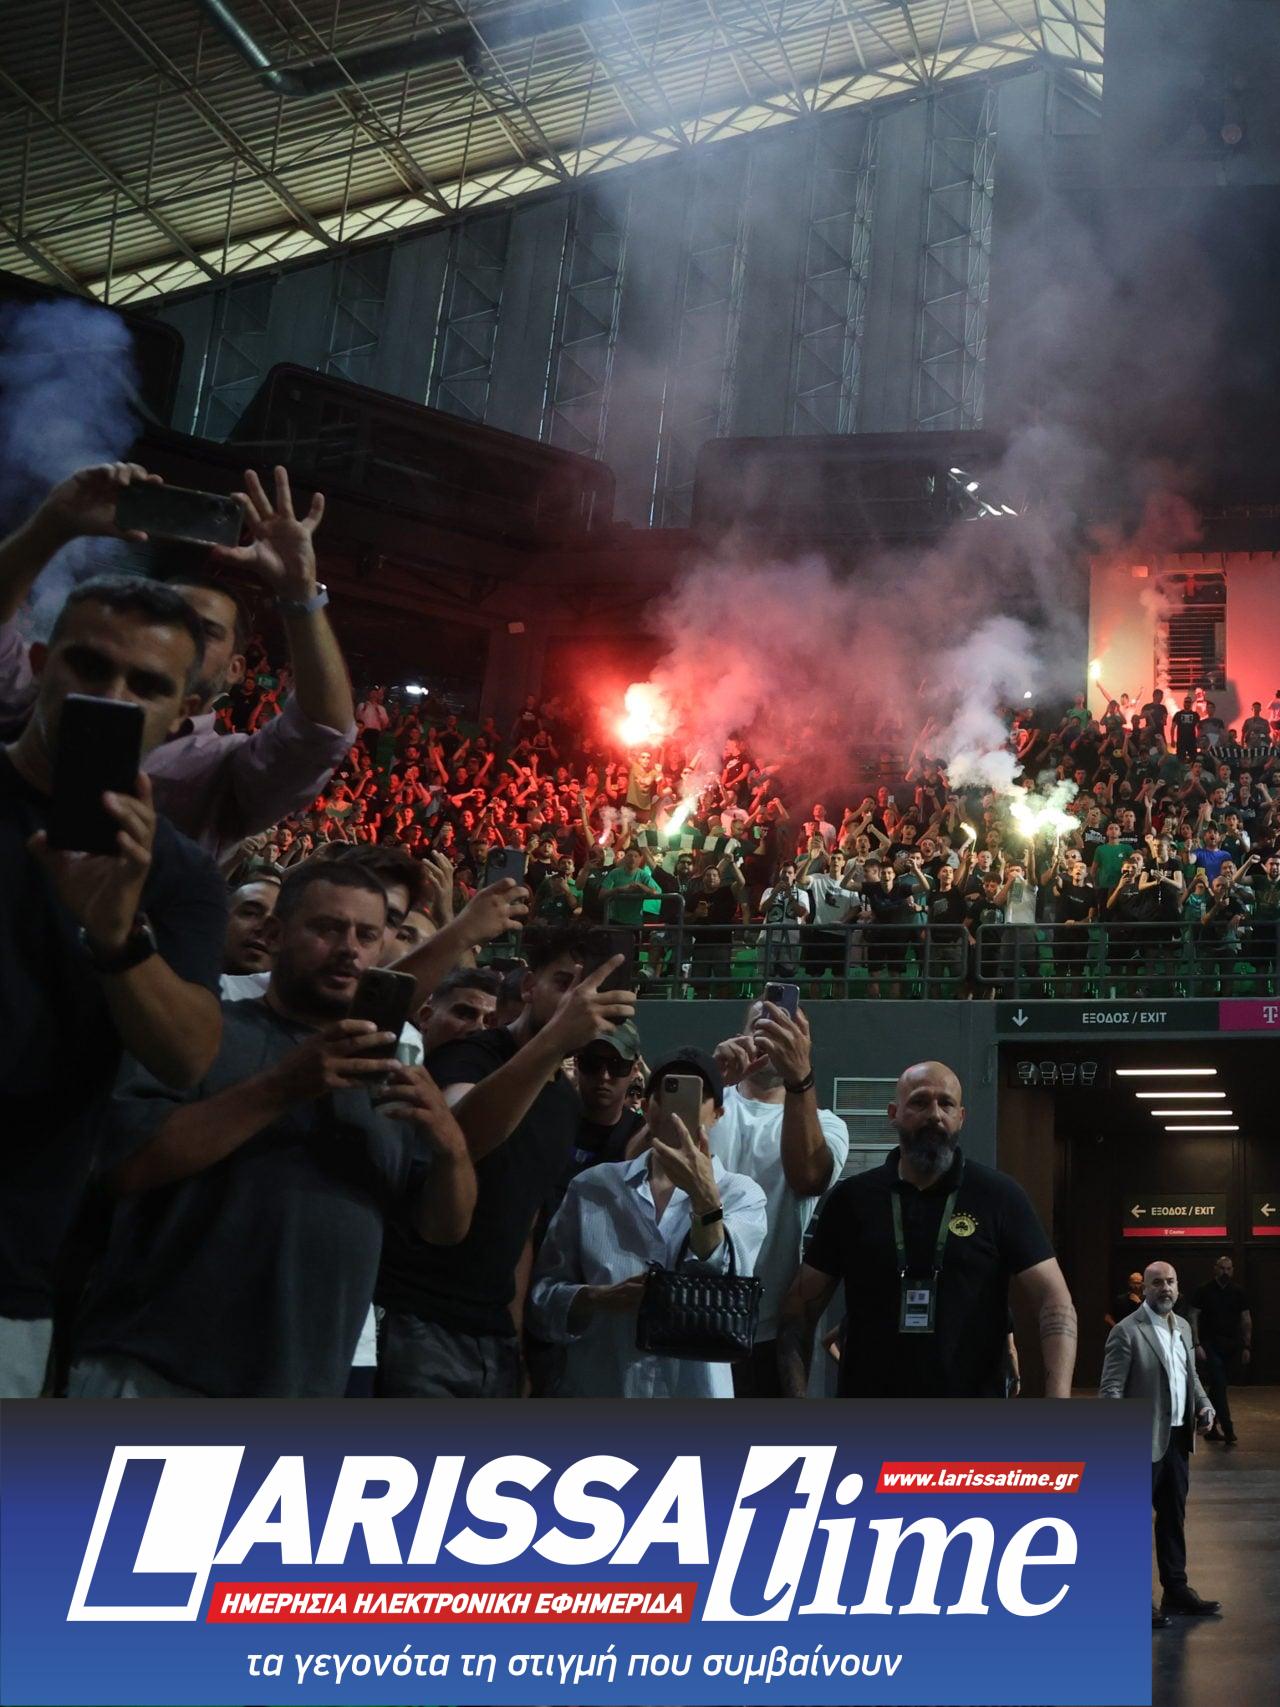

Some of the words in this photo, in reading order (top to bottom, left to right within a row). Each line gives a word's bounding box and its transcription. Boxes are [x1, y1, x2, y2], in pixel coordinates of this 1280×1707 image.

[1082, 1012, 1130, 1024] ΕΞΟΔΟΣ
[1131, 1011, 1138, 1024] /
[1140, 1012, 1168, 1023] EXIT
[1151, 1206, 1187, 1216] ΕΞΟΔΟΣ
[1194, 1205, 1215, 1216] EXIT
